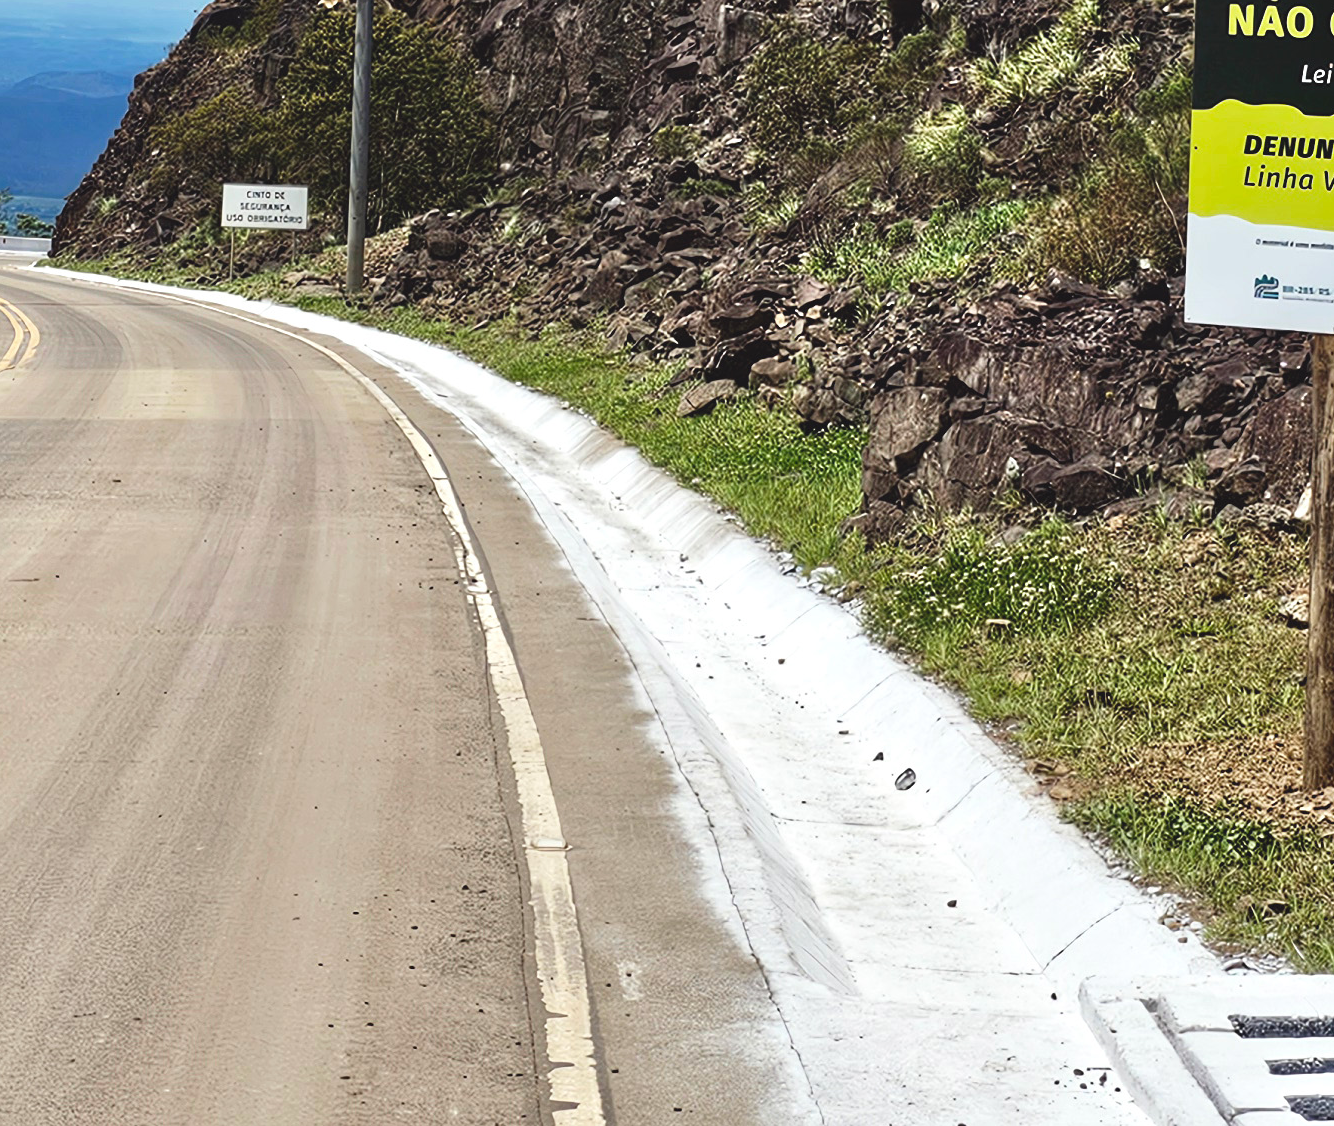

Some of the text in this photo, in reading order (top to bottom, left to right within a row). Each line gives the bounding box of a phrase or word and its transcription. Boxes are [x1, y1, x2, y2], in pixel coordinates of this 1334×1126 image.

[1301, 63, 1333, 86] Lei
[1243, 166, 1315, 191] Linha
[247, 191, 270, 199] CINTO
[240, 203, 290, 212] SEGURANÇA
